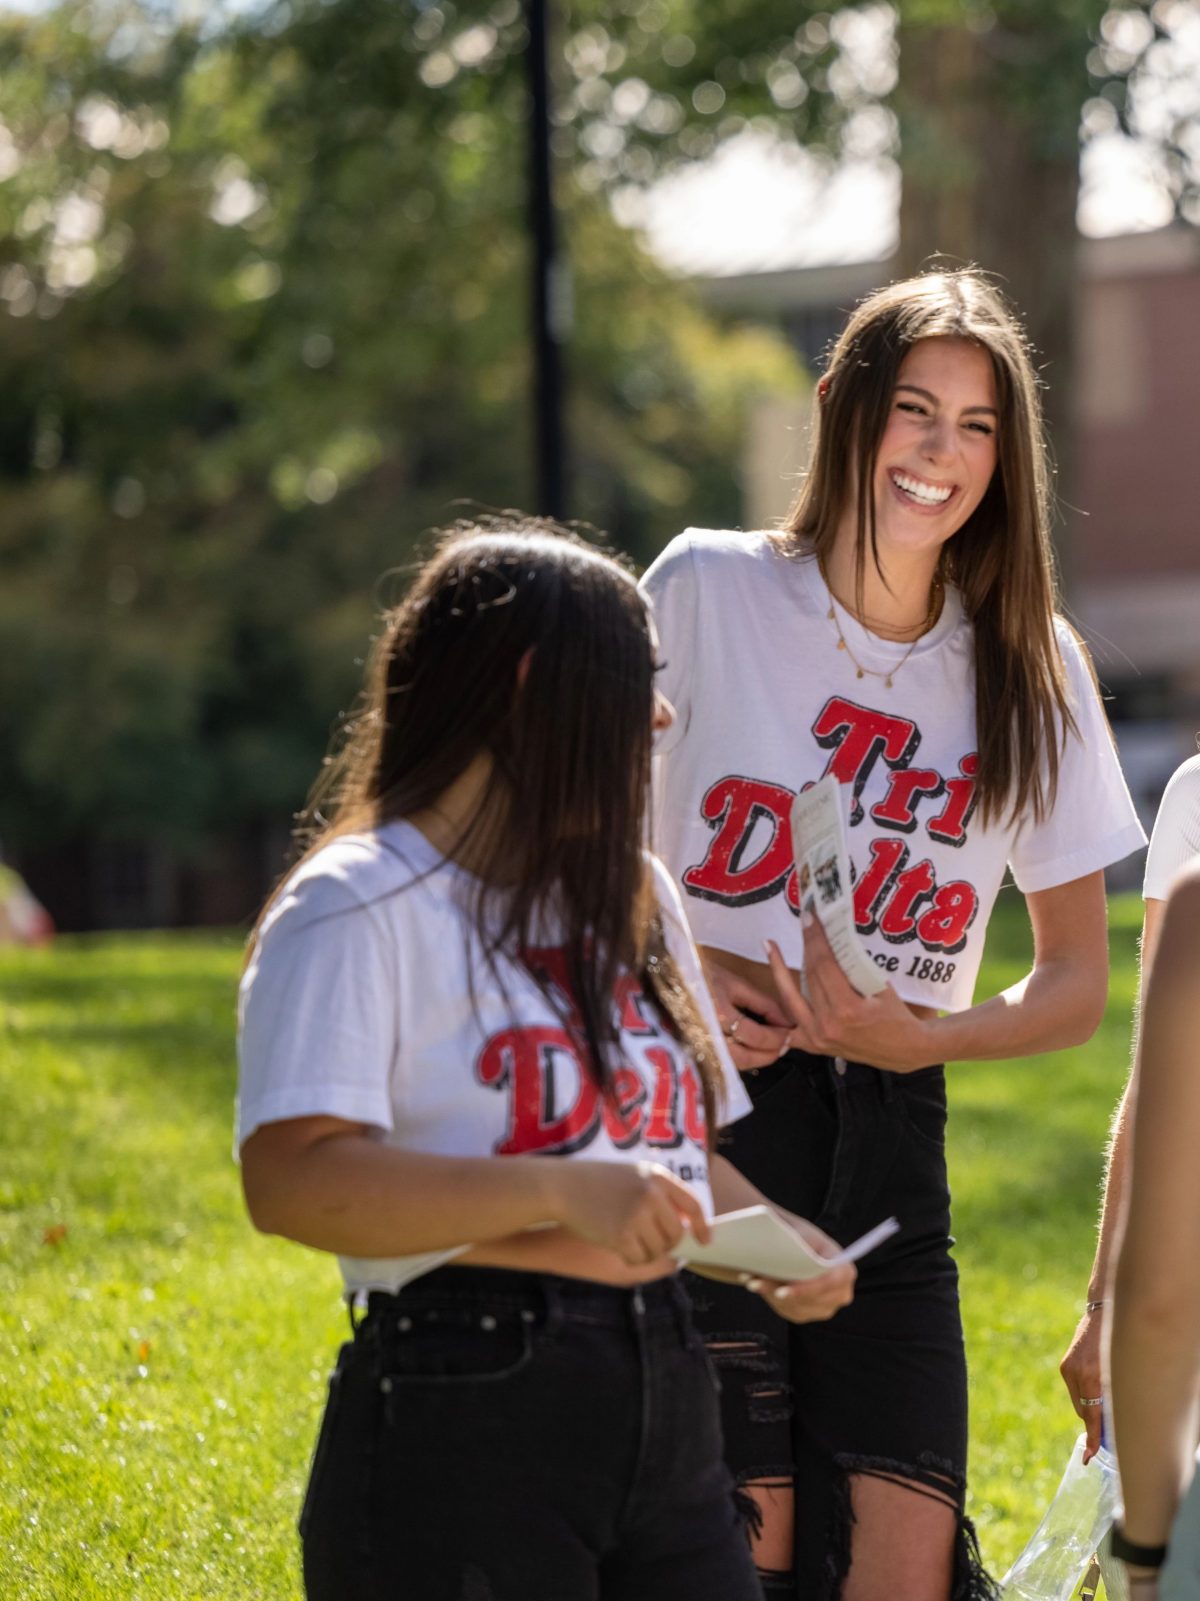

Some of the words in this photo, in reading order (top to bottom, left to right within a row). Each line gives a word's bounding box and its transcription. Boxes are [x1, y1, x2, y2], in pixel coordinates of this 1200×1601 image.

[800, 696, 977, 848] Tri
[682, 775, 979, 954] Dlta
[905, 956, 956, 983] 1888
[476, 1027, 708, 1156] Delt
